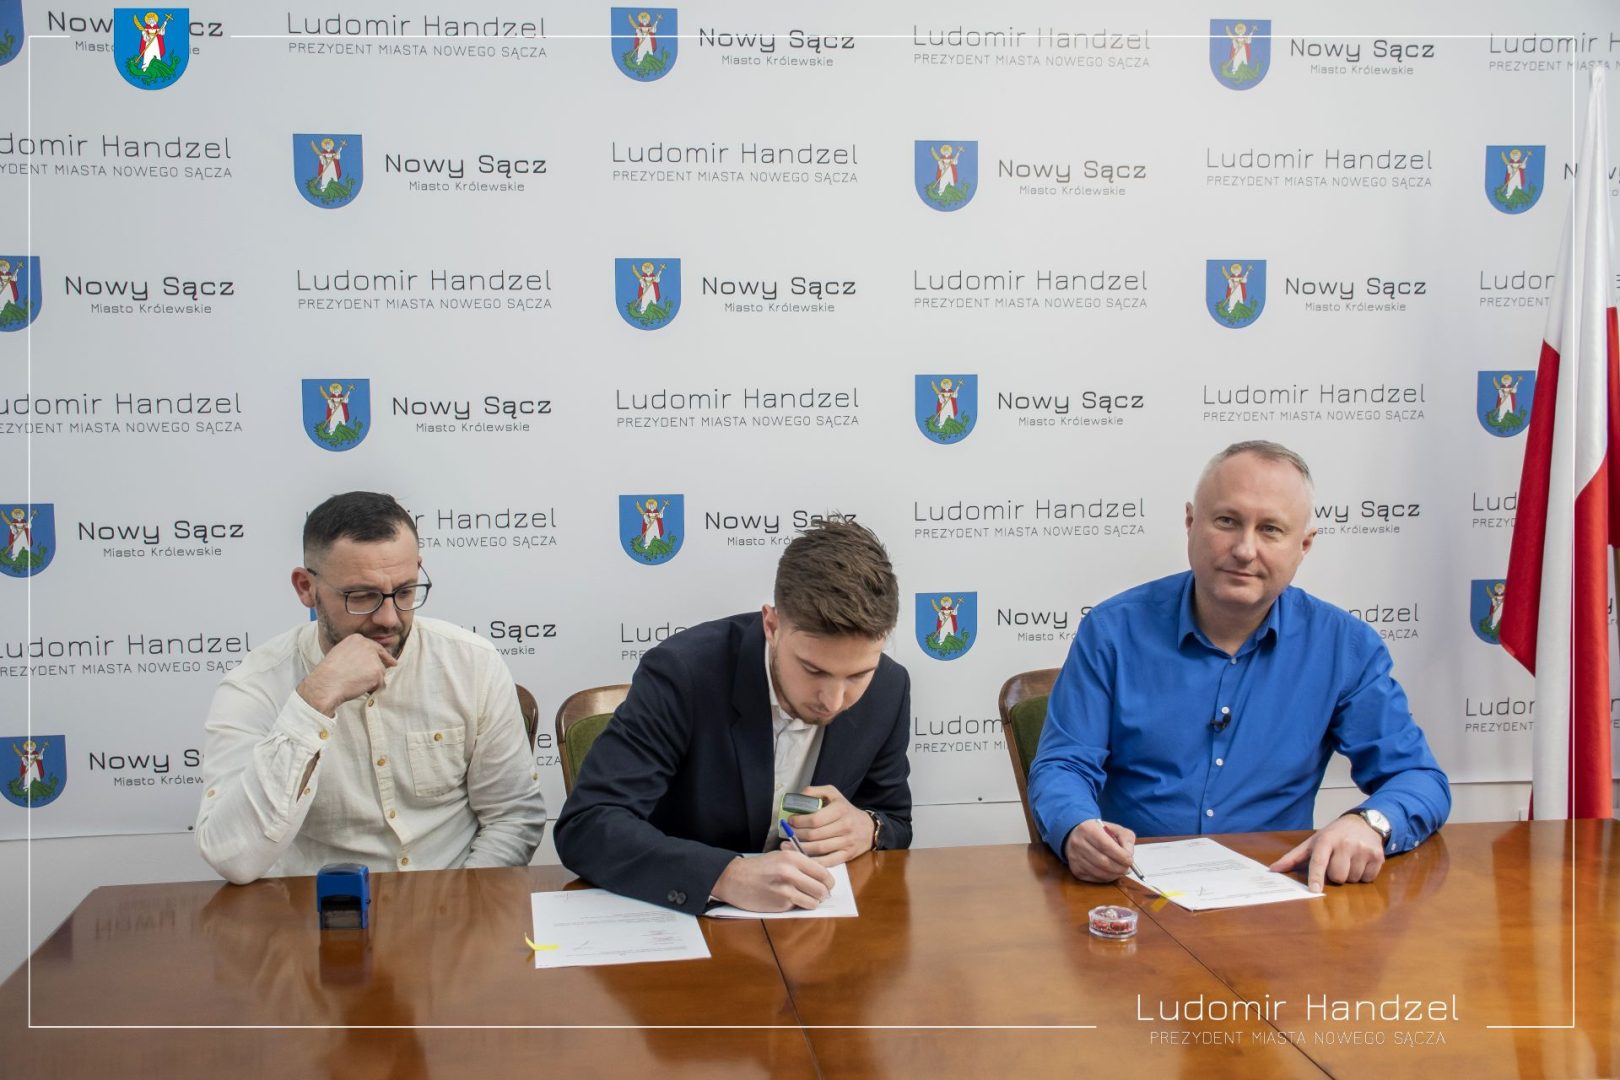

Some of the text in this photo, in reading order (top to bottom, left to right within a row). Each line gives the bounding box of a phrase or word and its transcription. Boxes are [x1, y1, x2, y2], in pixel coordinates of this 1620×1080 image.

[47, 9, 224, 38] Now cz
[287, 11, 547, 40] Ludomir Handzel
[75, 40, 114, 53] Miast
[699, 27, 856, 55] Nowy Sącz
[913, 24, 1151, 50] Ludomir Handzel
[1489, 31, 1599, 54] Ludomir
[288, 42, 548, 61] PREZYDENT MIASTA NOWEGO SĄCZA
[721, 54, 834, 67] Miasto Królewskie
[1290, 37, 1435, 64] Nowy Sącz
[913, 53, 1150, 70] PREZYDENT MIASTA NOWEGO SĄCZA
[1310, 63, 1414, 76] Miasto Królewskie
[1488, 60, 1562, 72] PREZYDENT
[0, 131, 232, 160] domir Handzel
[612, 140, 859, 166] Ludomir Handzel
[384, 152, 548, 180] Nowy Sącz
[1206, 146, 1433, 170] Ludomir Handzel
[0, 162, 233, 181] YDENT MIASTA NOWEGO SĄCZA
[612, 169, 858, 186] PREZYDENT MIASTA NOWEGO SĄCZA
[998, 159, 1147, 184] Nowy Sącz
[408, 180, 525, 192] Miasto Królewskie
[1019, 184, 1126, 196] Miasto Królewskie
[1206, 175, 1432, 190] PREZYDENT MIASTA NOWEGO SĄCZA
[64, 275, 235, 302] Nowy Sącz
[296, 268, 552, 292] Ludomir Handzel
[701, 275, 857, 301] Nowy Sącz
[913, 269, 1148, 292] Ludomir Handzel
[1285, 276, 1427, 301] Nowy Sącz
[90, 303, 212, 314] Miasto Królewskie
[297, 297, 553, 312] PREZYDENT MIASTA NOWEGO SĄCZA
[724, 301, 836, 313] Miasto Królewskie
[913, 296, 1148, 311] PREZYDENT MIASTA NOWEGO SĄCZA
[1305, 301, 1407, 312] Miasto Królewskie
[1479, 296, 1551, 308] PREZYDENT
[115, 391, 243, 415] Handzel
[615, 386, 860, 411] Ludomir Handzel
[997, 390, 1145, 415] Nowy Sącz
[1203, 383, 1426, 406] Ludomir Handzel
[391, 395, 553, 421] Nowy Sącz
[1203, 409, 1425, 423] PREZYDENT MIASTA NOWEGO SĄCZA
[69, 421, 121, 434] MIASTA
[125, 421, 190, 433] NOWEGO
[195, 420, 243, 436] SĄCZA
[415, 421, 530, 433] Miasto Królewskie
[616, 415, 860, 429] PREZYDENT MIASTA NOWEGO SĄCZA
[1018, 415, 1124, 427] Miasto Królewskie
[437, 506, 557, 531] Handzel
[914, 496, 1145, 522] Ludomir Handzel
[1314, 499, 1421, 524] wy Sącz
[77, 519, 245, 546] Nowy Sącz
[704, 510, 781, 535] Nowy
[914, 524, 1145, 540] PREZYDENT MIASTA NOWEGO SĄCZA
[1339, 524, 1401, 535] Królewskie
[103, 545, 222, 558] Miasto Królewskie
[446, 535, 508, 549] NOWEGO
[512, 535, 558, 550] SĄCZA
[727, 536, 766, 547] Miasto
[997, 607, 1069, 630] Nowy
[489, 620, 557, 644] Sącz
[1017, 631, 1055, 642] Miasto
[127, 631, 252, 656] Handzel
[0, 663, 77, 678] REZYDENT
[81, 663, 133, 675] MIASTA
[137, 660, 201, 674] NOWEGO
[914, 714, 1004, 737] Ludom
[914, 740, 989, 753] PREZYDENT
[88, 751, 170, 775] Nowy
[113, 774, 205, 787] Miasto Królew
